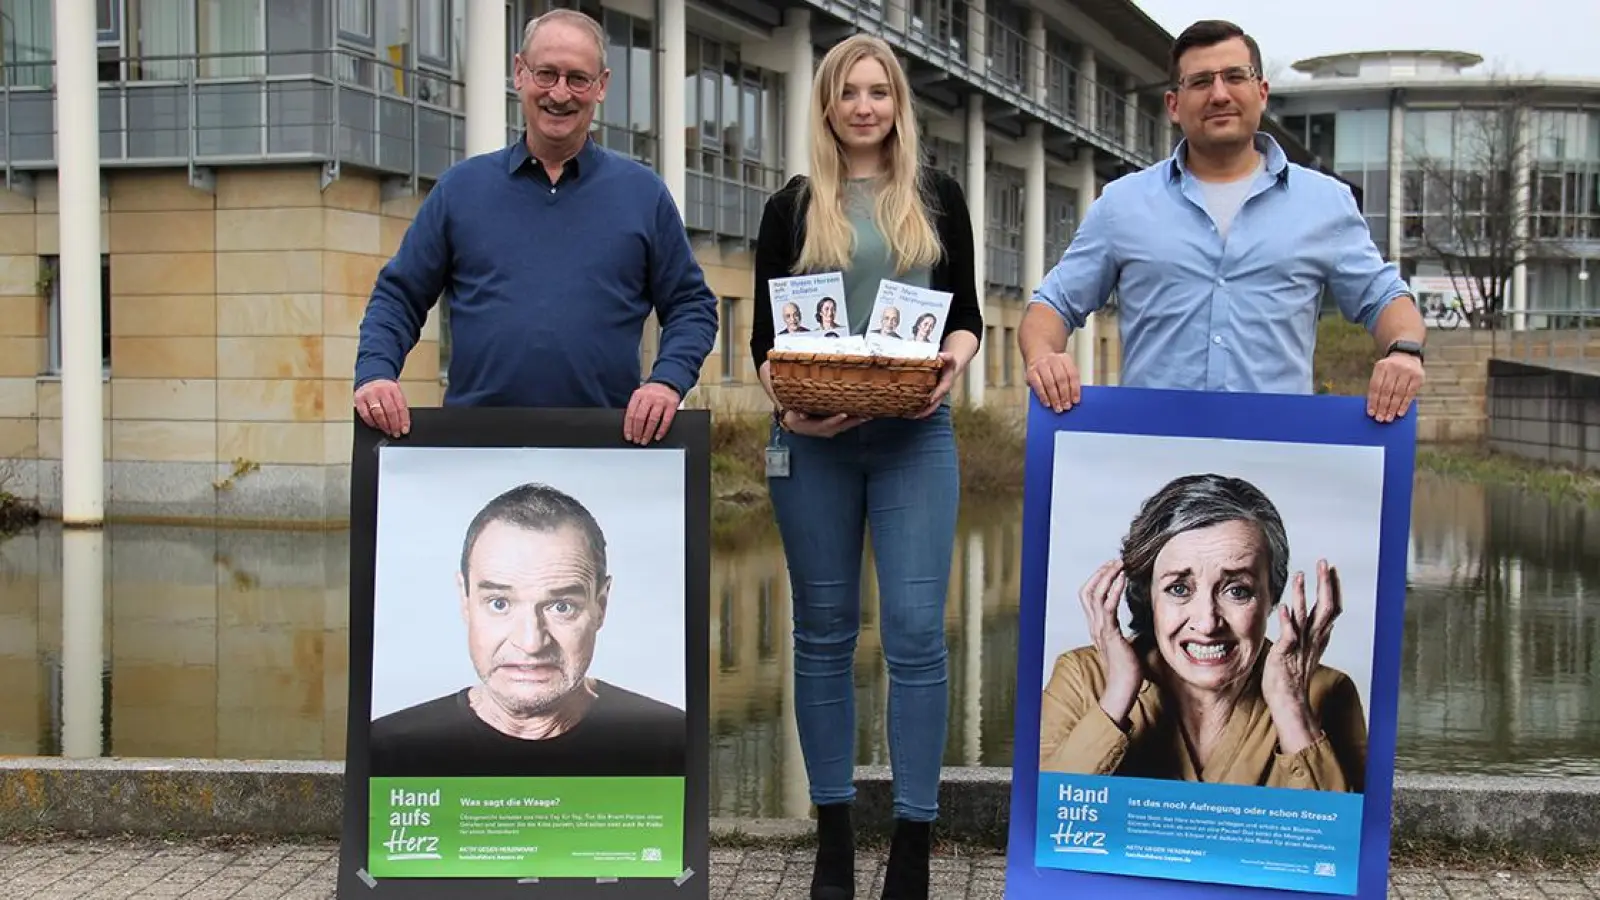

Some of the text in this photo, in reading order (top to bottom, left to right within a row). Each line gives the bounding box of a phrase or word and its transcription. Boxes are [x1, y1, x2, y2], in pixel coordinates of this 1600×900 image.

[390, 788, 441, 807] Hand
[460, 798, 560, 808] Was sagt die Waage?
[1059, 783, 1109, 804] Hand
[389, 808, 431, 826] aufs
[1057, 804, 1098, 822] aufs
[1128, 798, 1338, 821] Ist das noch Aufregung oder schon Stress?
[383, 826, 440, 853] Herz
[1049, 821, 1107, 847] Herz
